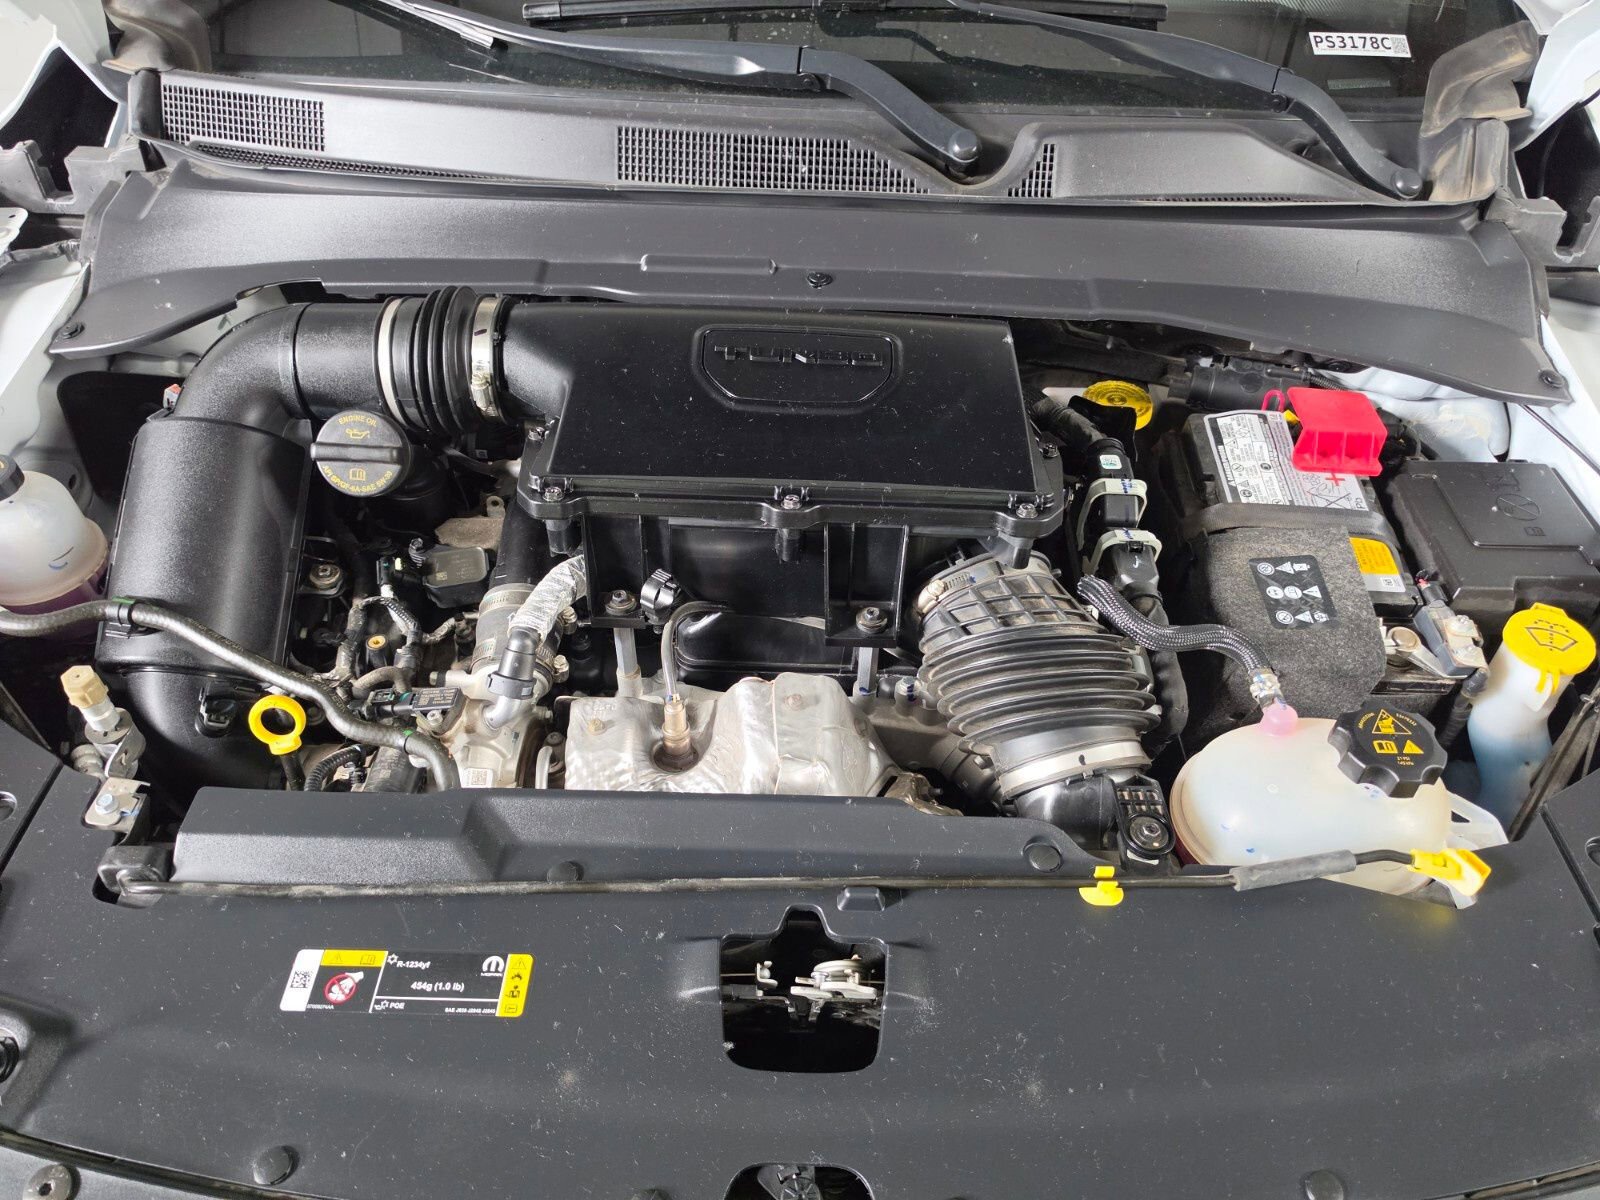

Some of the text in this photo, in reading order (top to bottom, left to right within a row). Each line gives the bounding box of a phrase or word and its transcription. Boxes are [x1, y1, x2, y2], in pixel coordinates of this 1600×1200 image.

[1312, 35, 1392, 50] PS3178C
[714, 344, 883, 367] TURBO
[338, 415, 377, 427] ENGINE OIL
[396, 960, 431, 970] R-1234yf
[410, 981, 465, 993] 454g (1.0 lb)
[389, 1001, 406, 1010] POE
